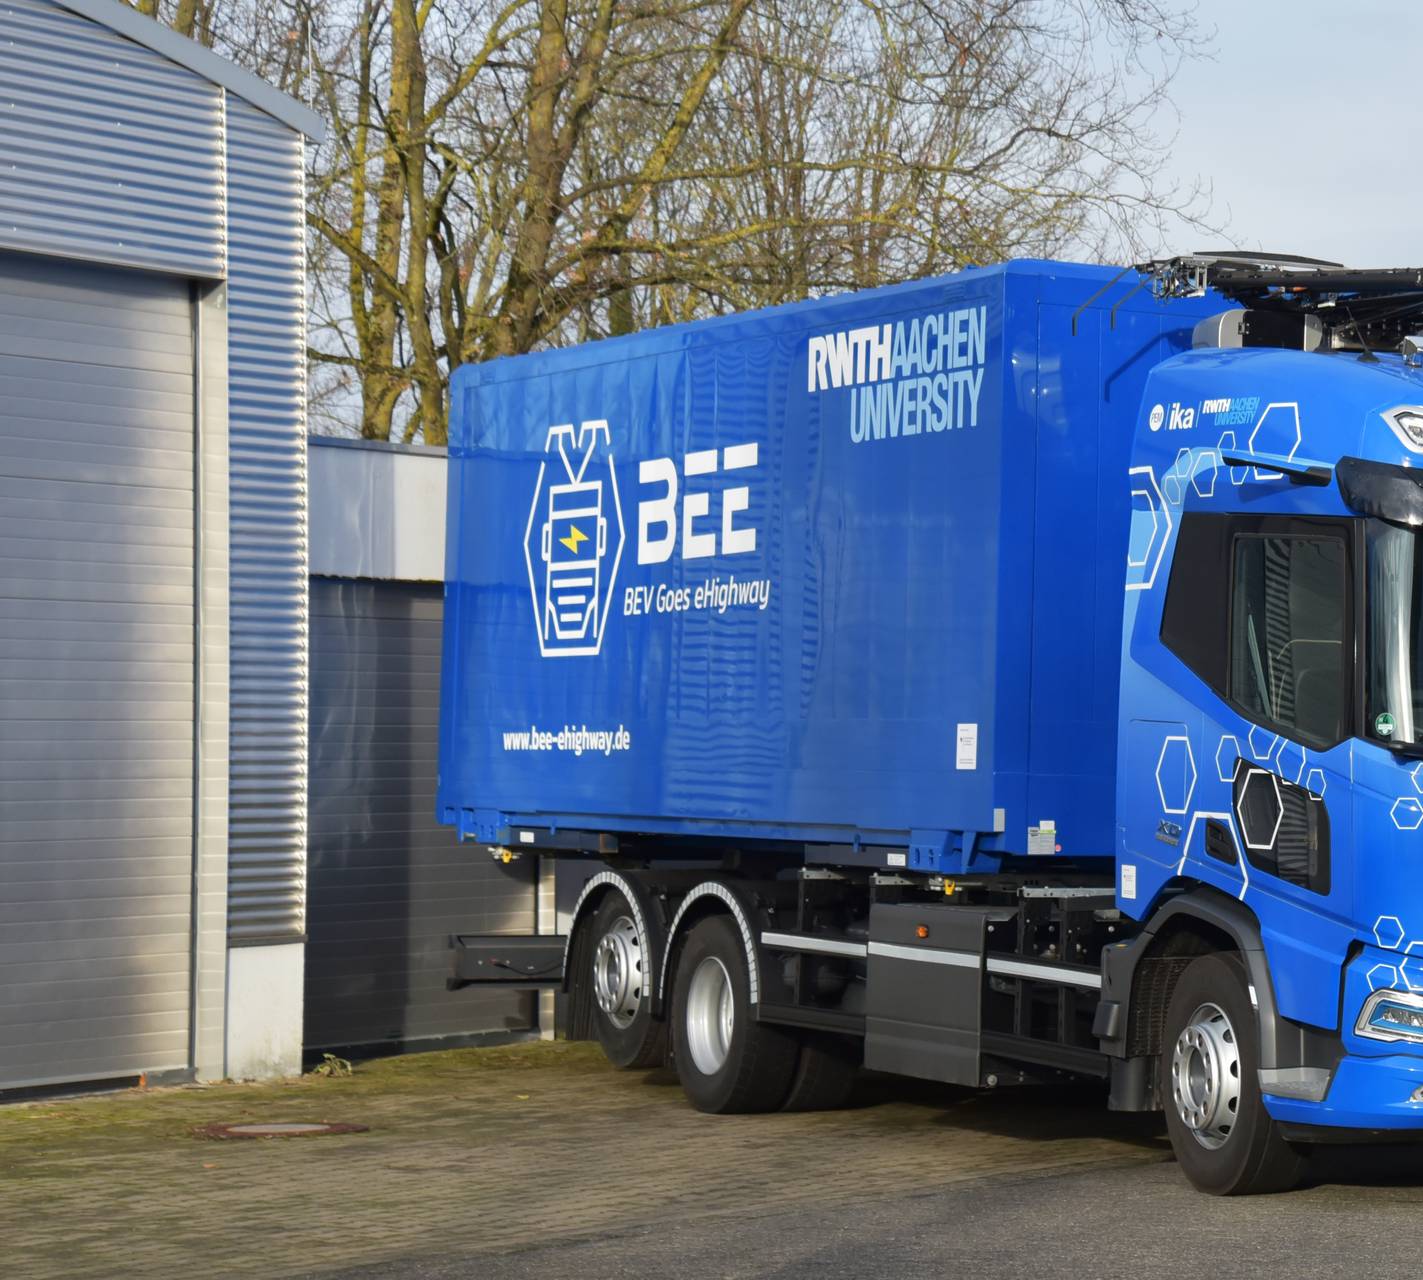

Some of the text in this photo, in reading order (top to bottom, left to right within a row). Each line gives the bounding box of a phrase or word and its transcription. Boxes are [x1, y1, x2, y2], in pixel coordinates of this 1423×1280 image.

[850, 368, 985, 443] UNIVERSITY
[1169, 402, 1195, 430] ika
[1214, 411, 1257, 426] UNIVERSITY
[637, 442, 758, 565] BEE
[623, 575, 770, 616] BEV Goes eHighway
[503, 724, 630, 756] www.bee-ehighway.de
